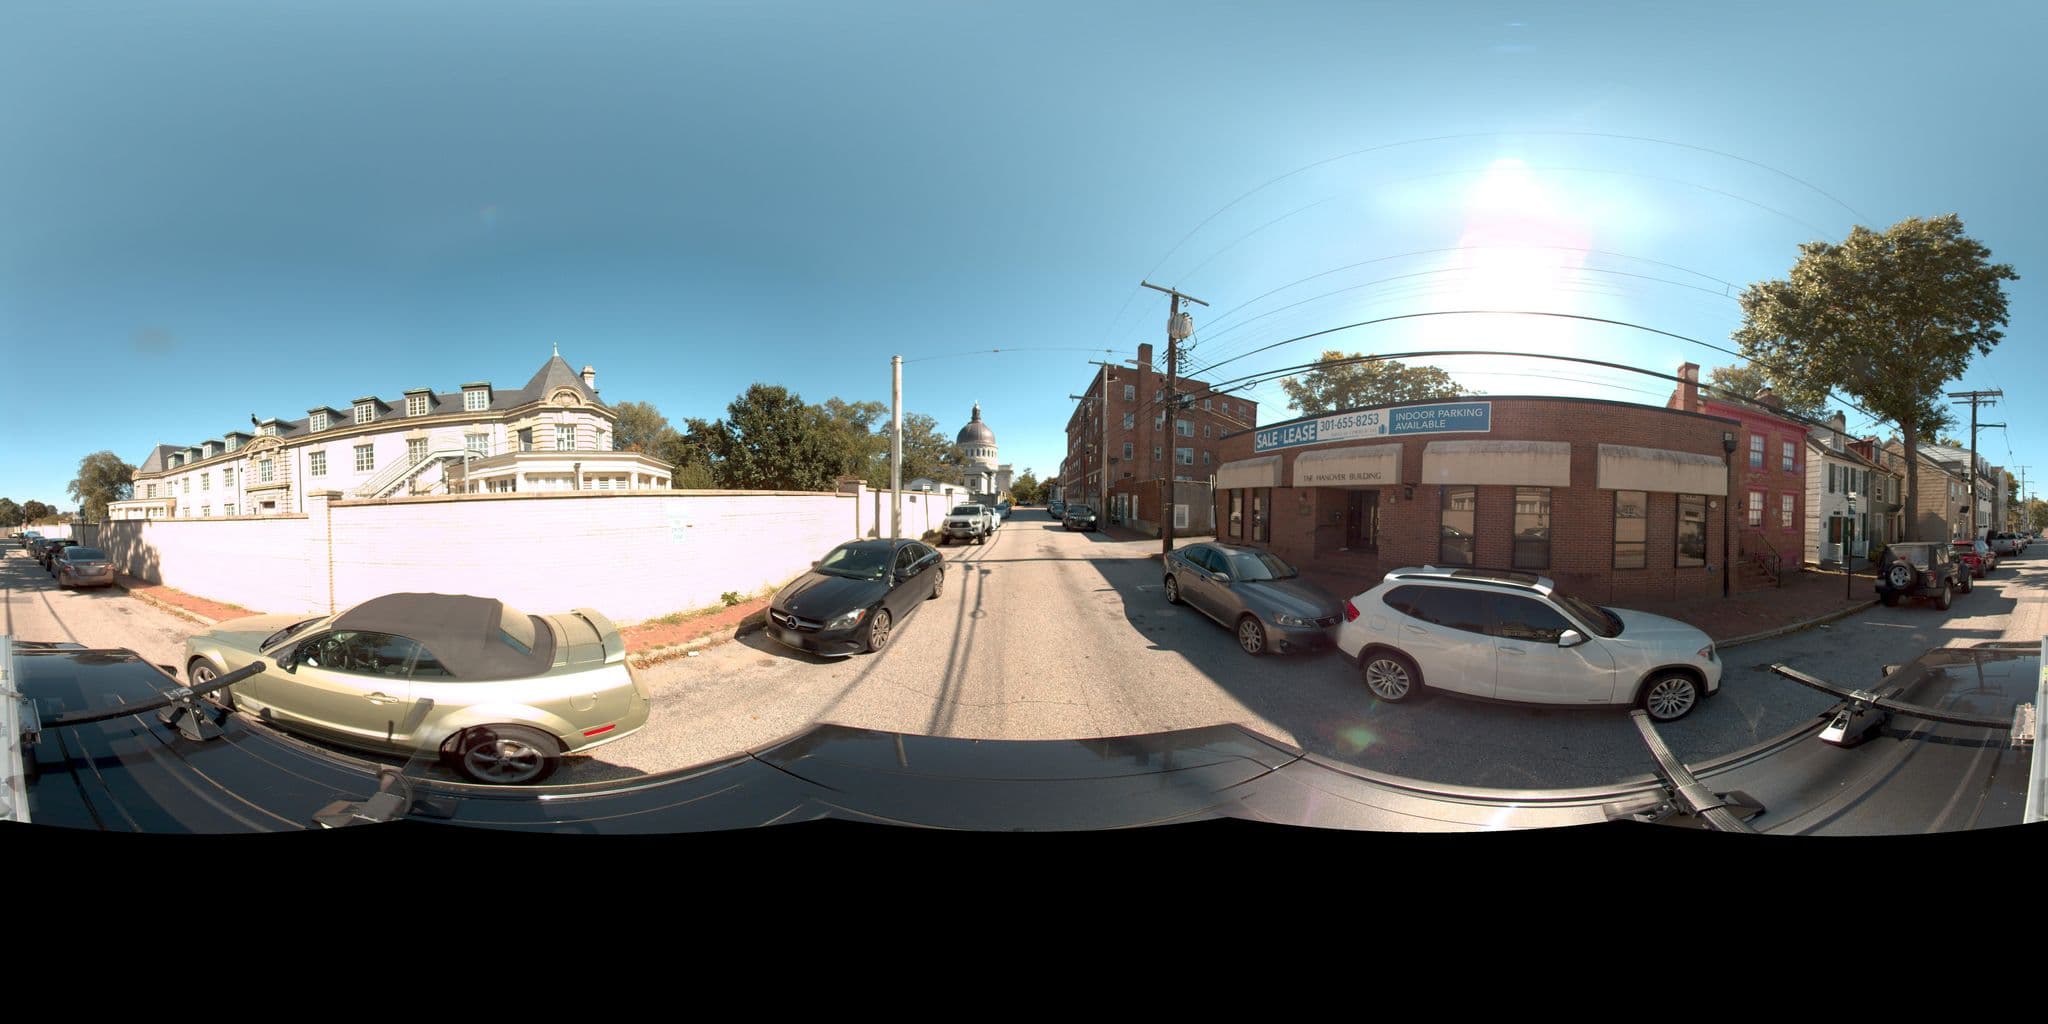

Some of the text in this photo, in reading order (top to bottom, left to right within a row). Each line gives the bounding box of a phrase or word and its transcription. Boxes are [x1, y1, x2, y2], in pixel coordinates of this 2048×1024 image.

[1395, 408, 1483, 421] INDOOR PARKING
[1320, 413, 1379, 432] 301-655-8253
[1395, 420, 1446, 431] AVAILABLE
[1256, 431, 1278, 449] SALE
[1283, 423, 1316, 444] LEASE
[1349, 472, 1382, 480] BUILDING
